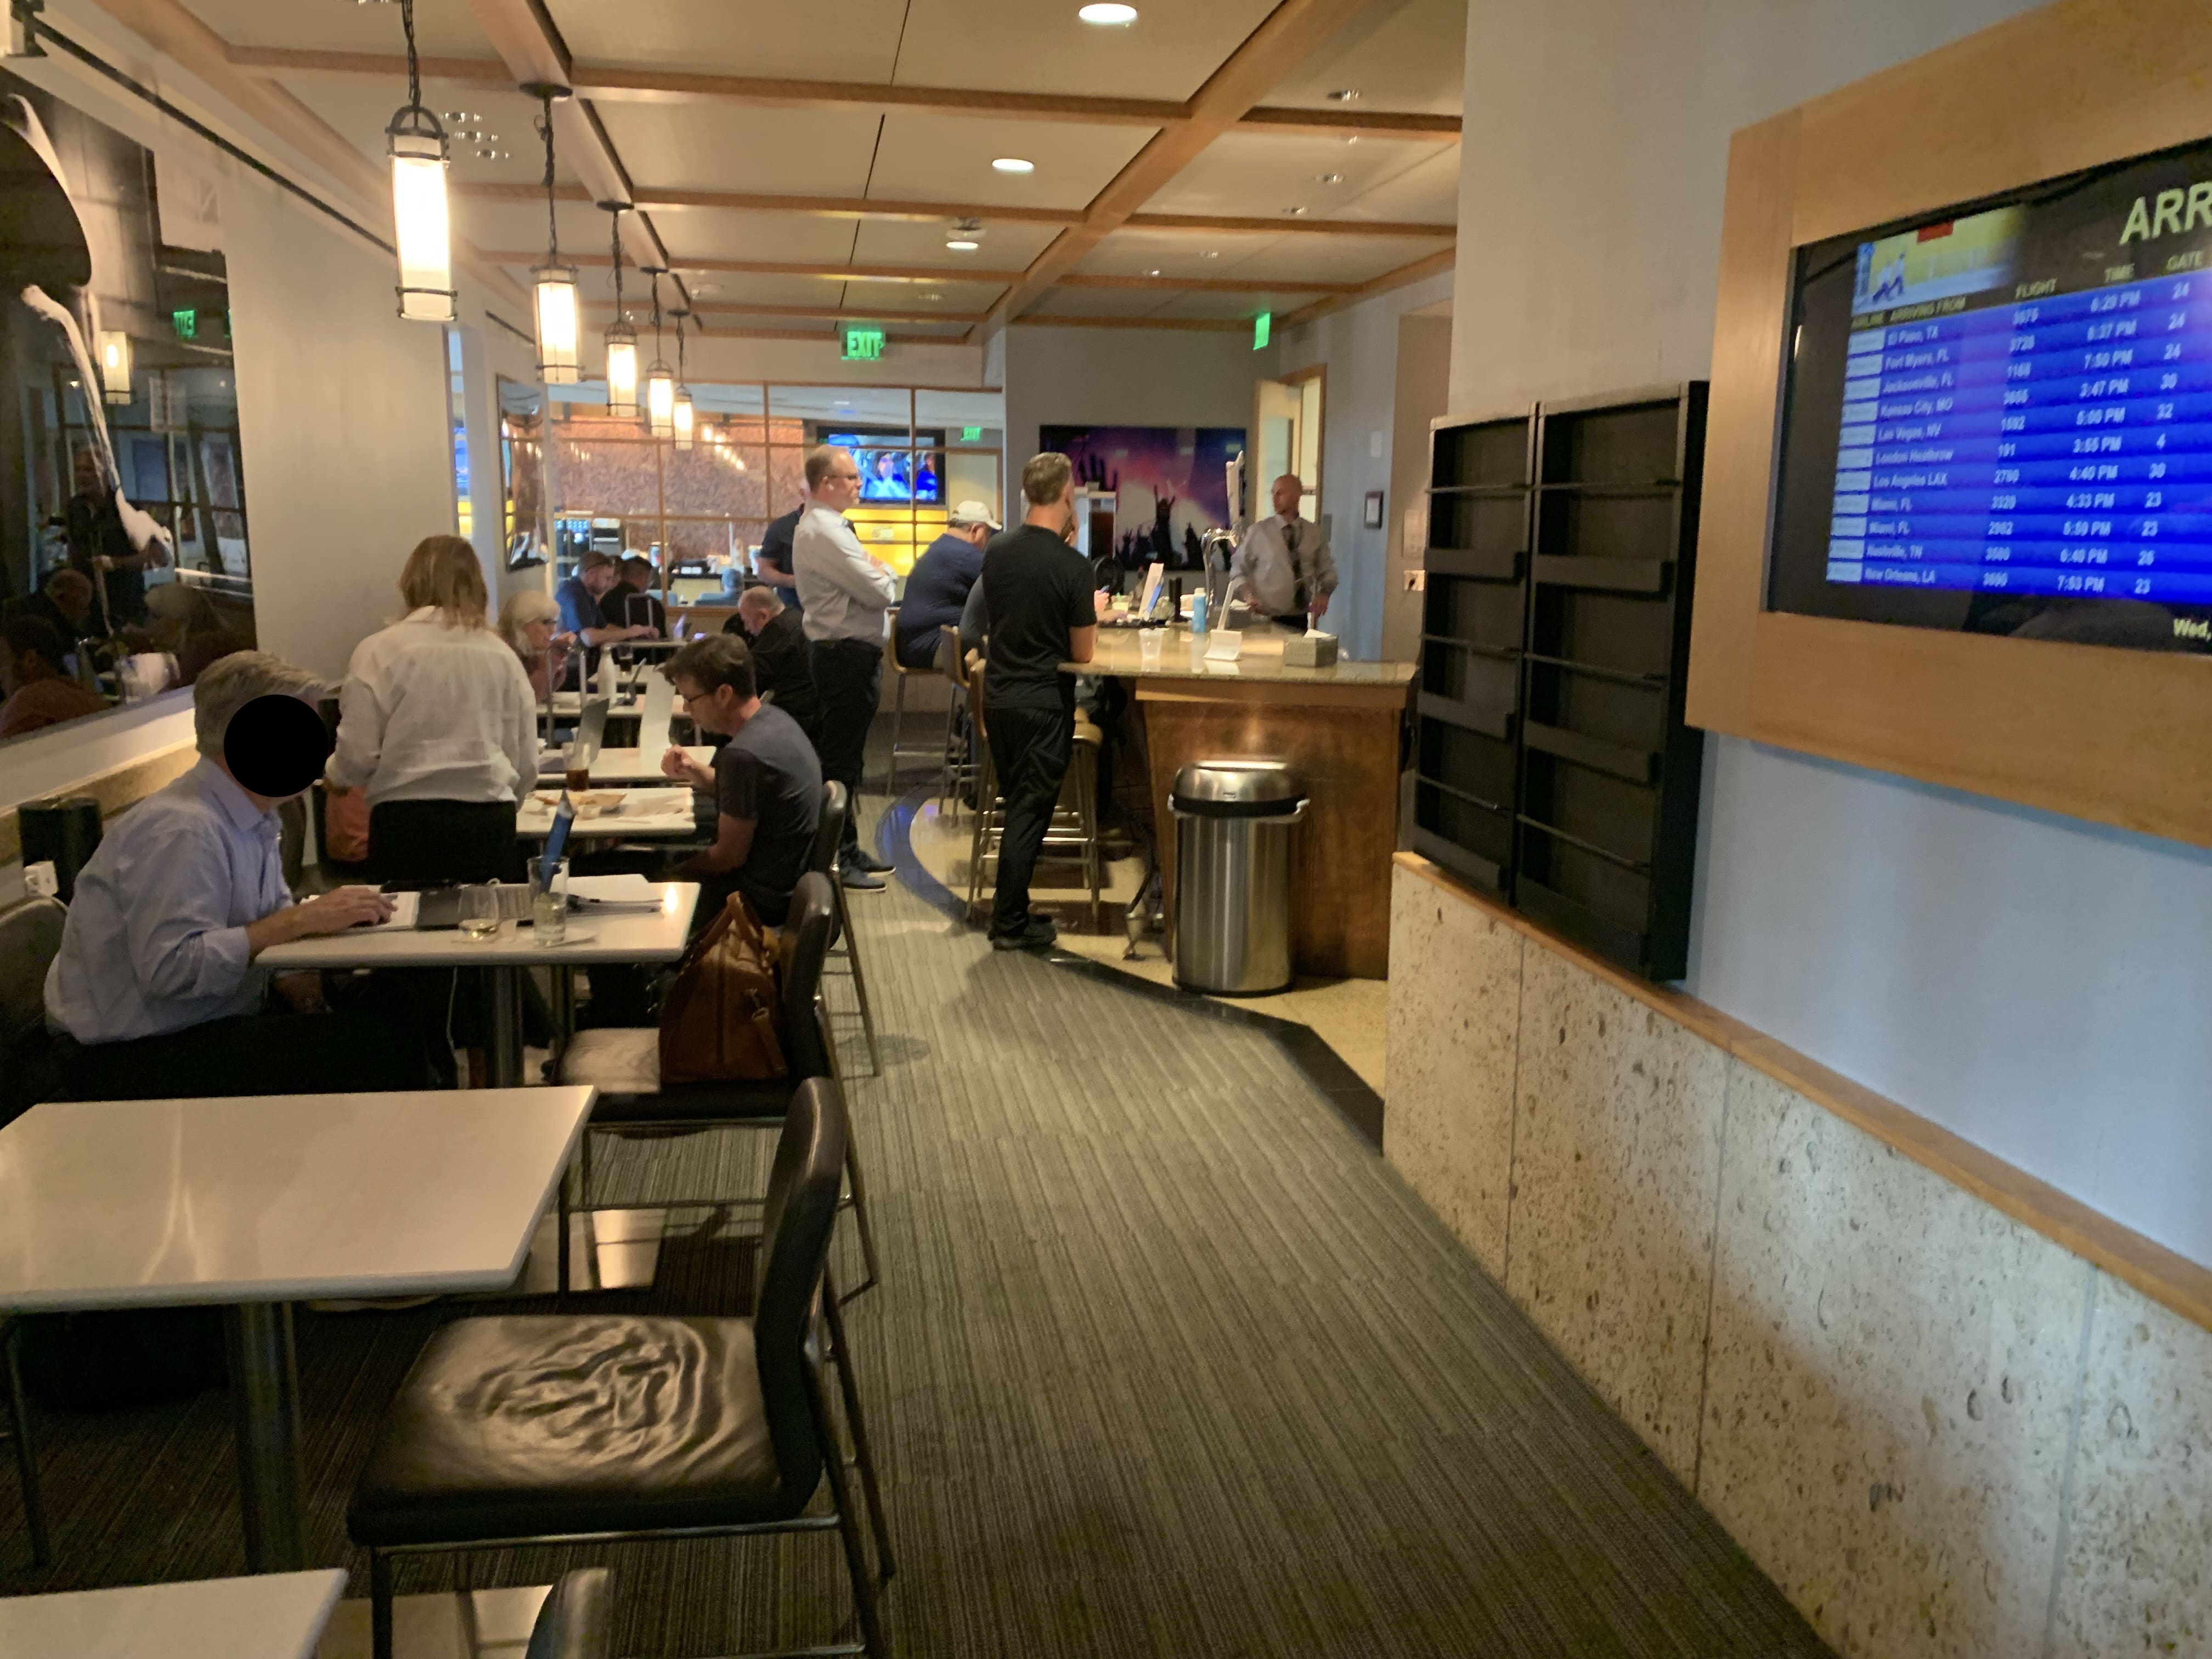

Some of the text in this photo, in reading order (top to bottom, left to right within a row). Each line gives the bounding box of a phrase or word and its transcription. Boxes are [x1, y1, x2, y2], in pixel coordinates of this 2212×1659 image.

[1937, 296, 1966, 313] FROM
[2016, 279, 2057, 298] FLIGHT
[2104, 263, 2135, 283] TIME
[2167, 250, 2204, 270] GATE
[1927, 325, 1938, 339] TX
[2120, 290, 2141, 307] PM
[2172, 282, 2189, 300] 24
[847, 331, 882, 357] EXIT
[1937, 348, 1949, 362] FL
[2115, 319, 2137, 337] PM
[2168, 312, 2185, 330] 24
[2113, 349, 2133, 366] PM
[2164, 343, 2181, 359] 24
[1936, 397, 1953, 411] MO
[2108, 379, 2129, 395] PM
[1878, 428, 1894, 440] Las
[1927, 423, 1942, 437] NV
[2104, 407, 2125, 423] PM
[1876, 450, 1909, 464] London
[2101, 436, 2121, 452] PM
[1874, 473, 1889, 488] Los
[1891, 474, 1926, 489] Angeles
[1928, 472, 1948, 486] LAX
[2098, 465, 2119, 481] PM
[1900, 497, 1912, 511] FL
[2094, 493, 2115, 509] PM
[2145, 492, 2162, 508] 23
[1898, 521, 1910, 535] FL
[2091, 521, 2111, 536] PM
[2141, 521, 2158, 537] 23
[1910, 545, 1922, 558] TN
[2087, 548, 2108, 563] PM
[1922, 570, 1935, 584] LA
[2085, 577, 2104, 592] PM
[2174, 618, 2211, 642] Wed,
